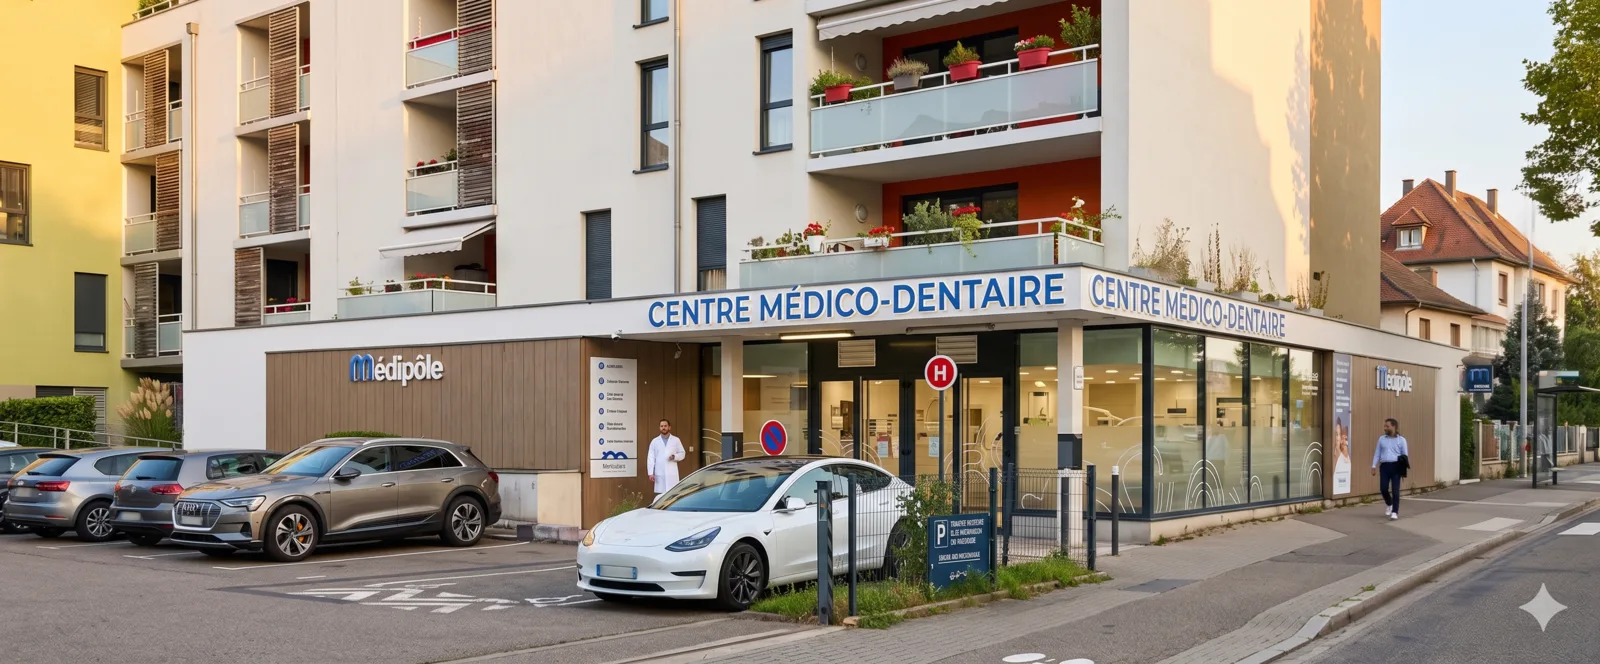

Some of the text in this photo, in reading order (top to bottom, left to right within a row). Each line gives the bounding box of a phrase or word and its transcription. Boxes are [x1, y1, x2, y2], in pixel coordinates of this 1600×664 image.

[649, 273, 1064, 328] CENTRE MÉDICO-DENTAIRE
[1091, 274, 1286, 337] CENTRE MÉDICO-DENTAIRE
[934, 365, 947, 381] H
[937, 524, 946, 545] P
